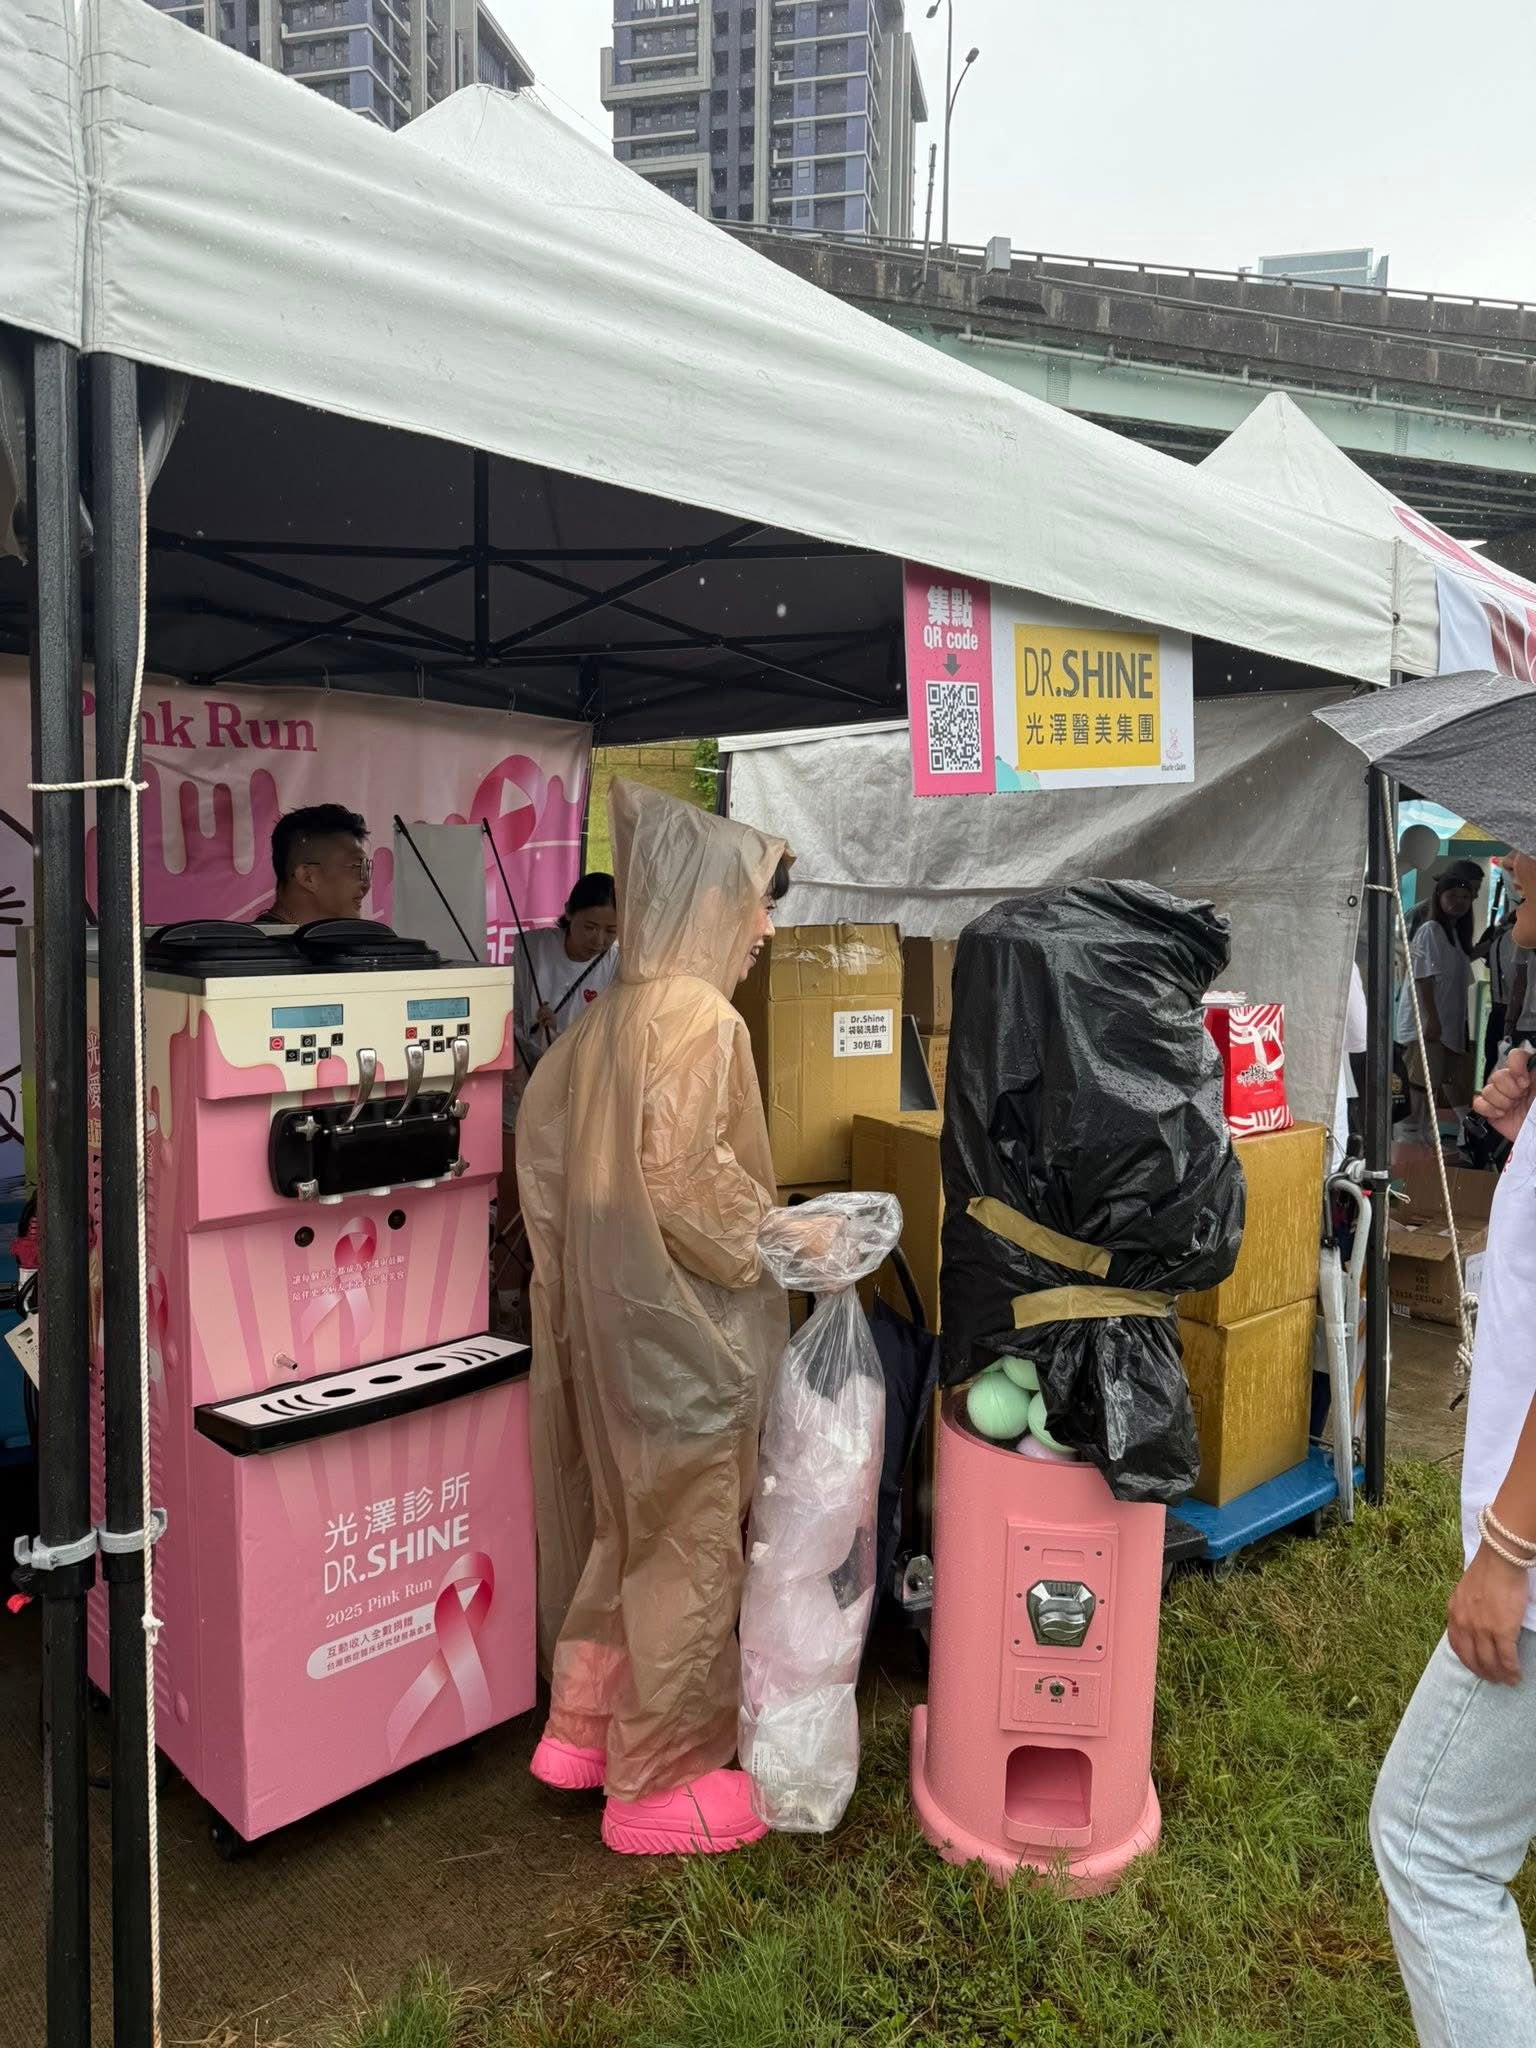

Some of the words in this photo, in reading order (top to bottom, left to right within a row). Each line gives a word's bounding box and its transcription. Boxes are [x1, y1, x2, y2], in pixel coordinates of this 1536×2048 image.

[928, 584, 973, 628] 集點
[924, 625, 943, 649] QR
[946, 629, 979, 650] code
[1024, 647, 1153, 699] DR.SHINE
[204, 701, 318, 752] Run
[1026, 712, 1154, 745] 光澤醫美集團
[850, 1014, 885, 1024] Dr.Shine
[324, 1472, 470, 1554] 光澤診所
[324, 1513, 470, 1595] DR.SHINE
[325, 1602, 363, 1629] 2025
[367, 1590, 401, 1613] Pink
[405, 1579, 433, 1598] Run
